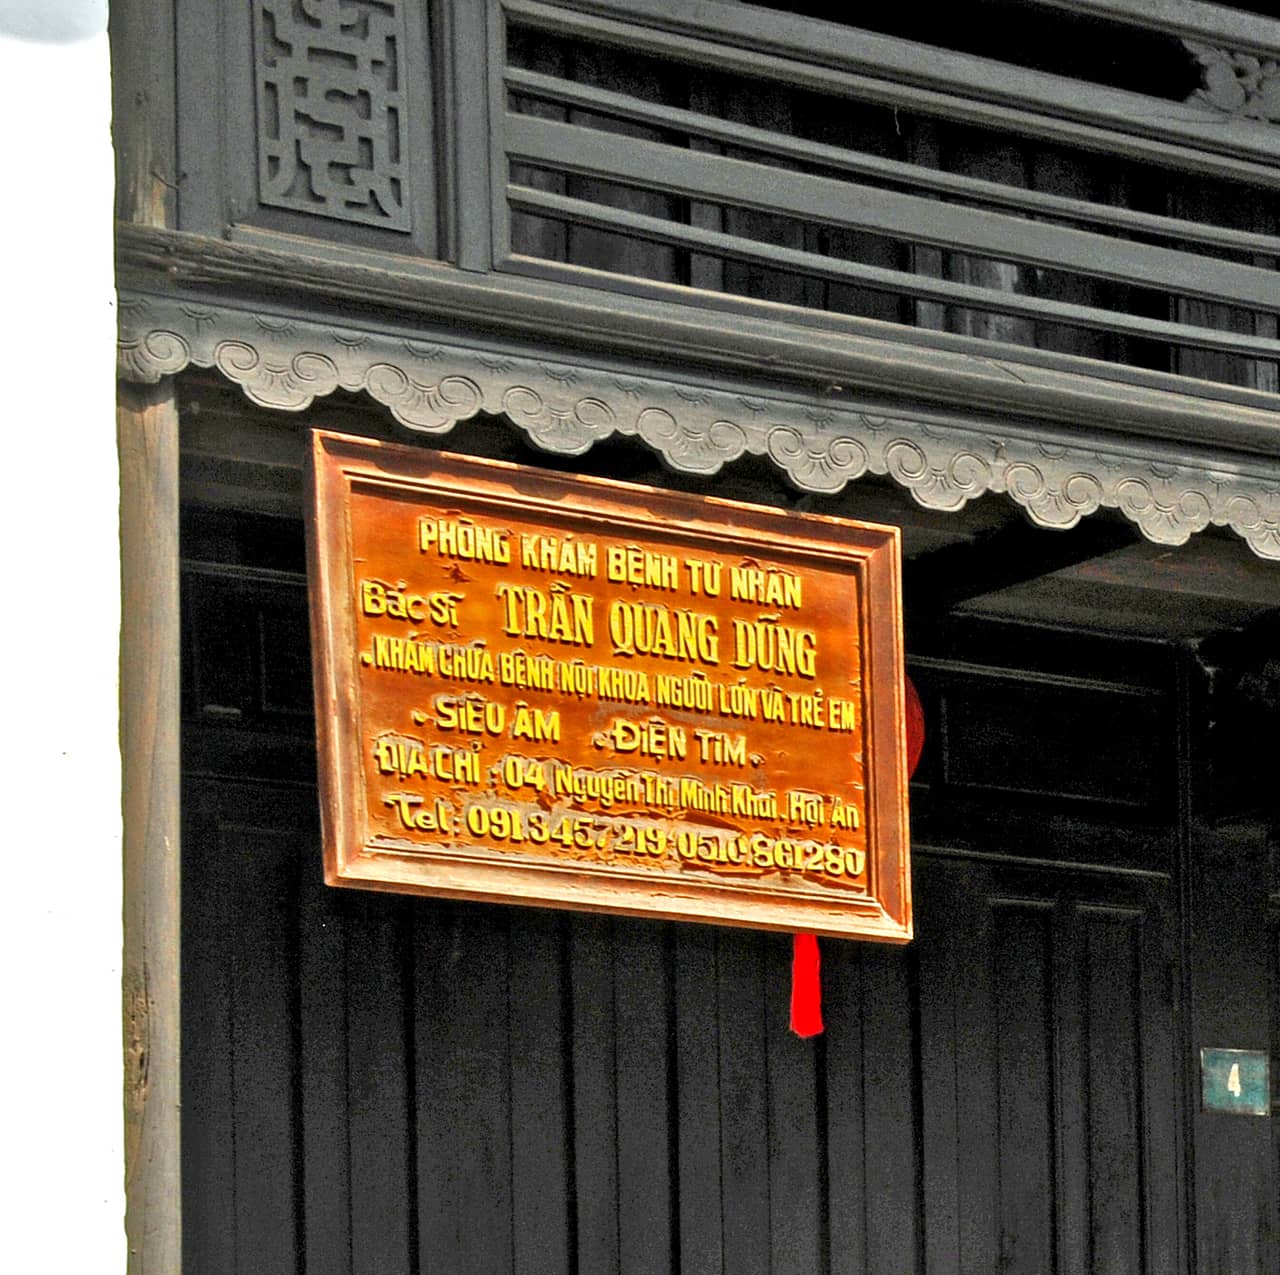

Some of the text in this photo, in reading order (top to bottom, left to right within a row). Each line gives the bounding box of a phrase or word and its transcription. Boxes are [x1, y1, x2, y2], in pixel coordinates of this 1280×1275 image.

[418, 515, 802, 608] PHÒNG KHÁM BỆNH TƯ NHÂN
[362, 580, 426, 620] Bác
[498, 581, 594, 645] TRẦN
[610, 600, 720, 664] QUANG
[731, 613, 817, 678] DŨNG
[375, 631, 434, 673] KHÁM
[500, 648, 554, 690] BỆNH
[559, 659, 593, 698] NỘI
[598, 665, 651, 702] KHOA
[656, 670, 713, 712] NGƯỜI
[719, 677, 758, 719] LỚN
[760, 686, 785, 722] VÀ
[787, 688, 825, 728] TRẺ
[829, 698, 856, 731] EM
[513, 700, 561, 741] ÂM
[376, 741, 430, 780] ĐỊA
[434, 740, 481, 783] CHỈ
[504, 756, 547, 791] 04
[555, 763, 640, 807] Nguyễn
[640, 772, 674, 811] Thị
[680, 778, 728, 813] Minh
[1227, 1062, 1241, 1097] 4
